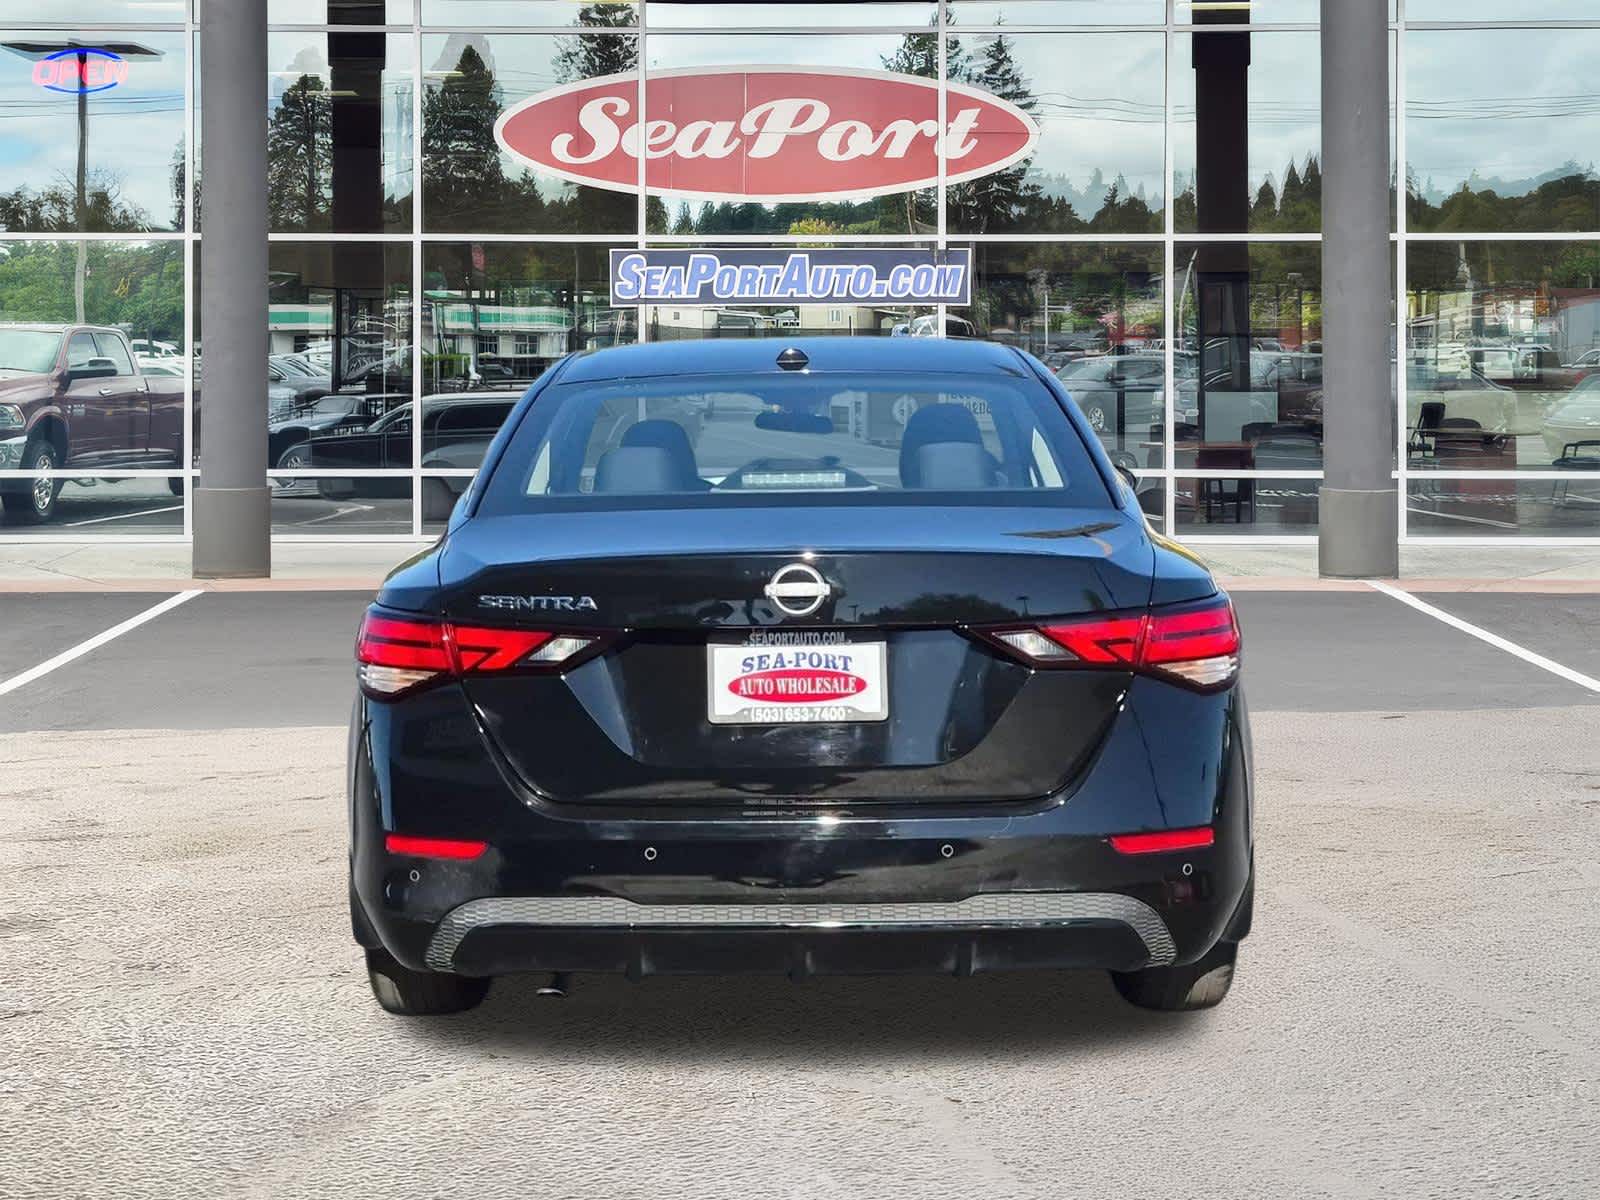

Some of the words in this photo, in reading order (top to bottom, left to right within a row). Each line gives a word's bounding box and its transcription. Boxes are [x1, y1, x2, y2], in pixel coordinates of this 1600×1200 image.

[32, 60, 128, 86] OPEN
[551, 97, 981, 164] SeaPort
[478, 595, 598, 610] SENTRA
[749, 632, 846, 645] SEAPORTAUTO.COM
[742, 652, 853, 673] SEA-PORT
[738, 678, 774, 695] AUTO
[777, 677, 857, 694] WHOLESALE
